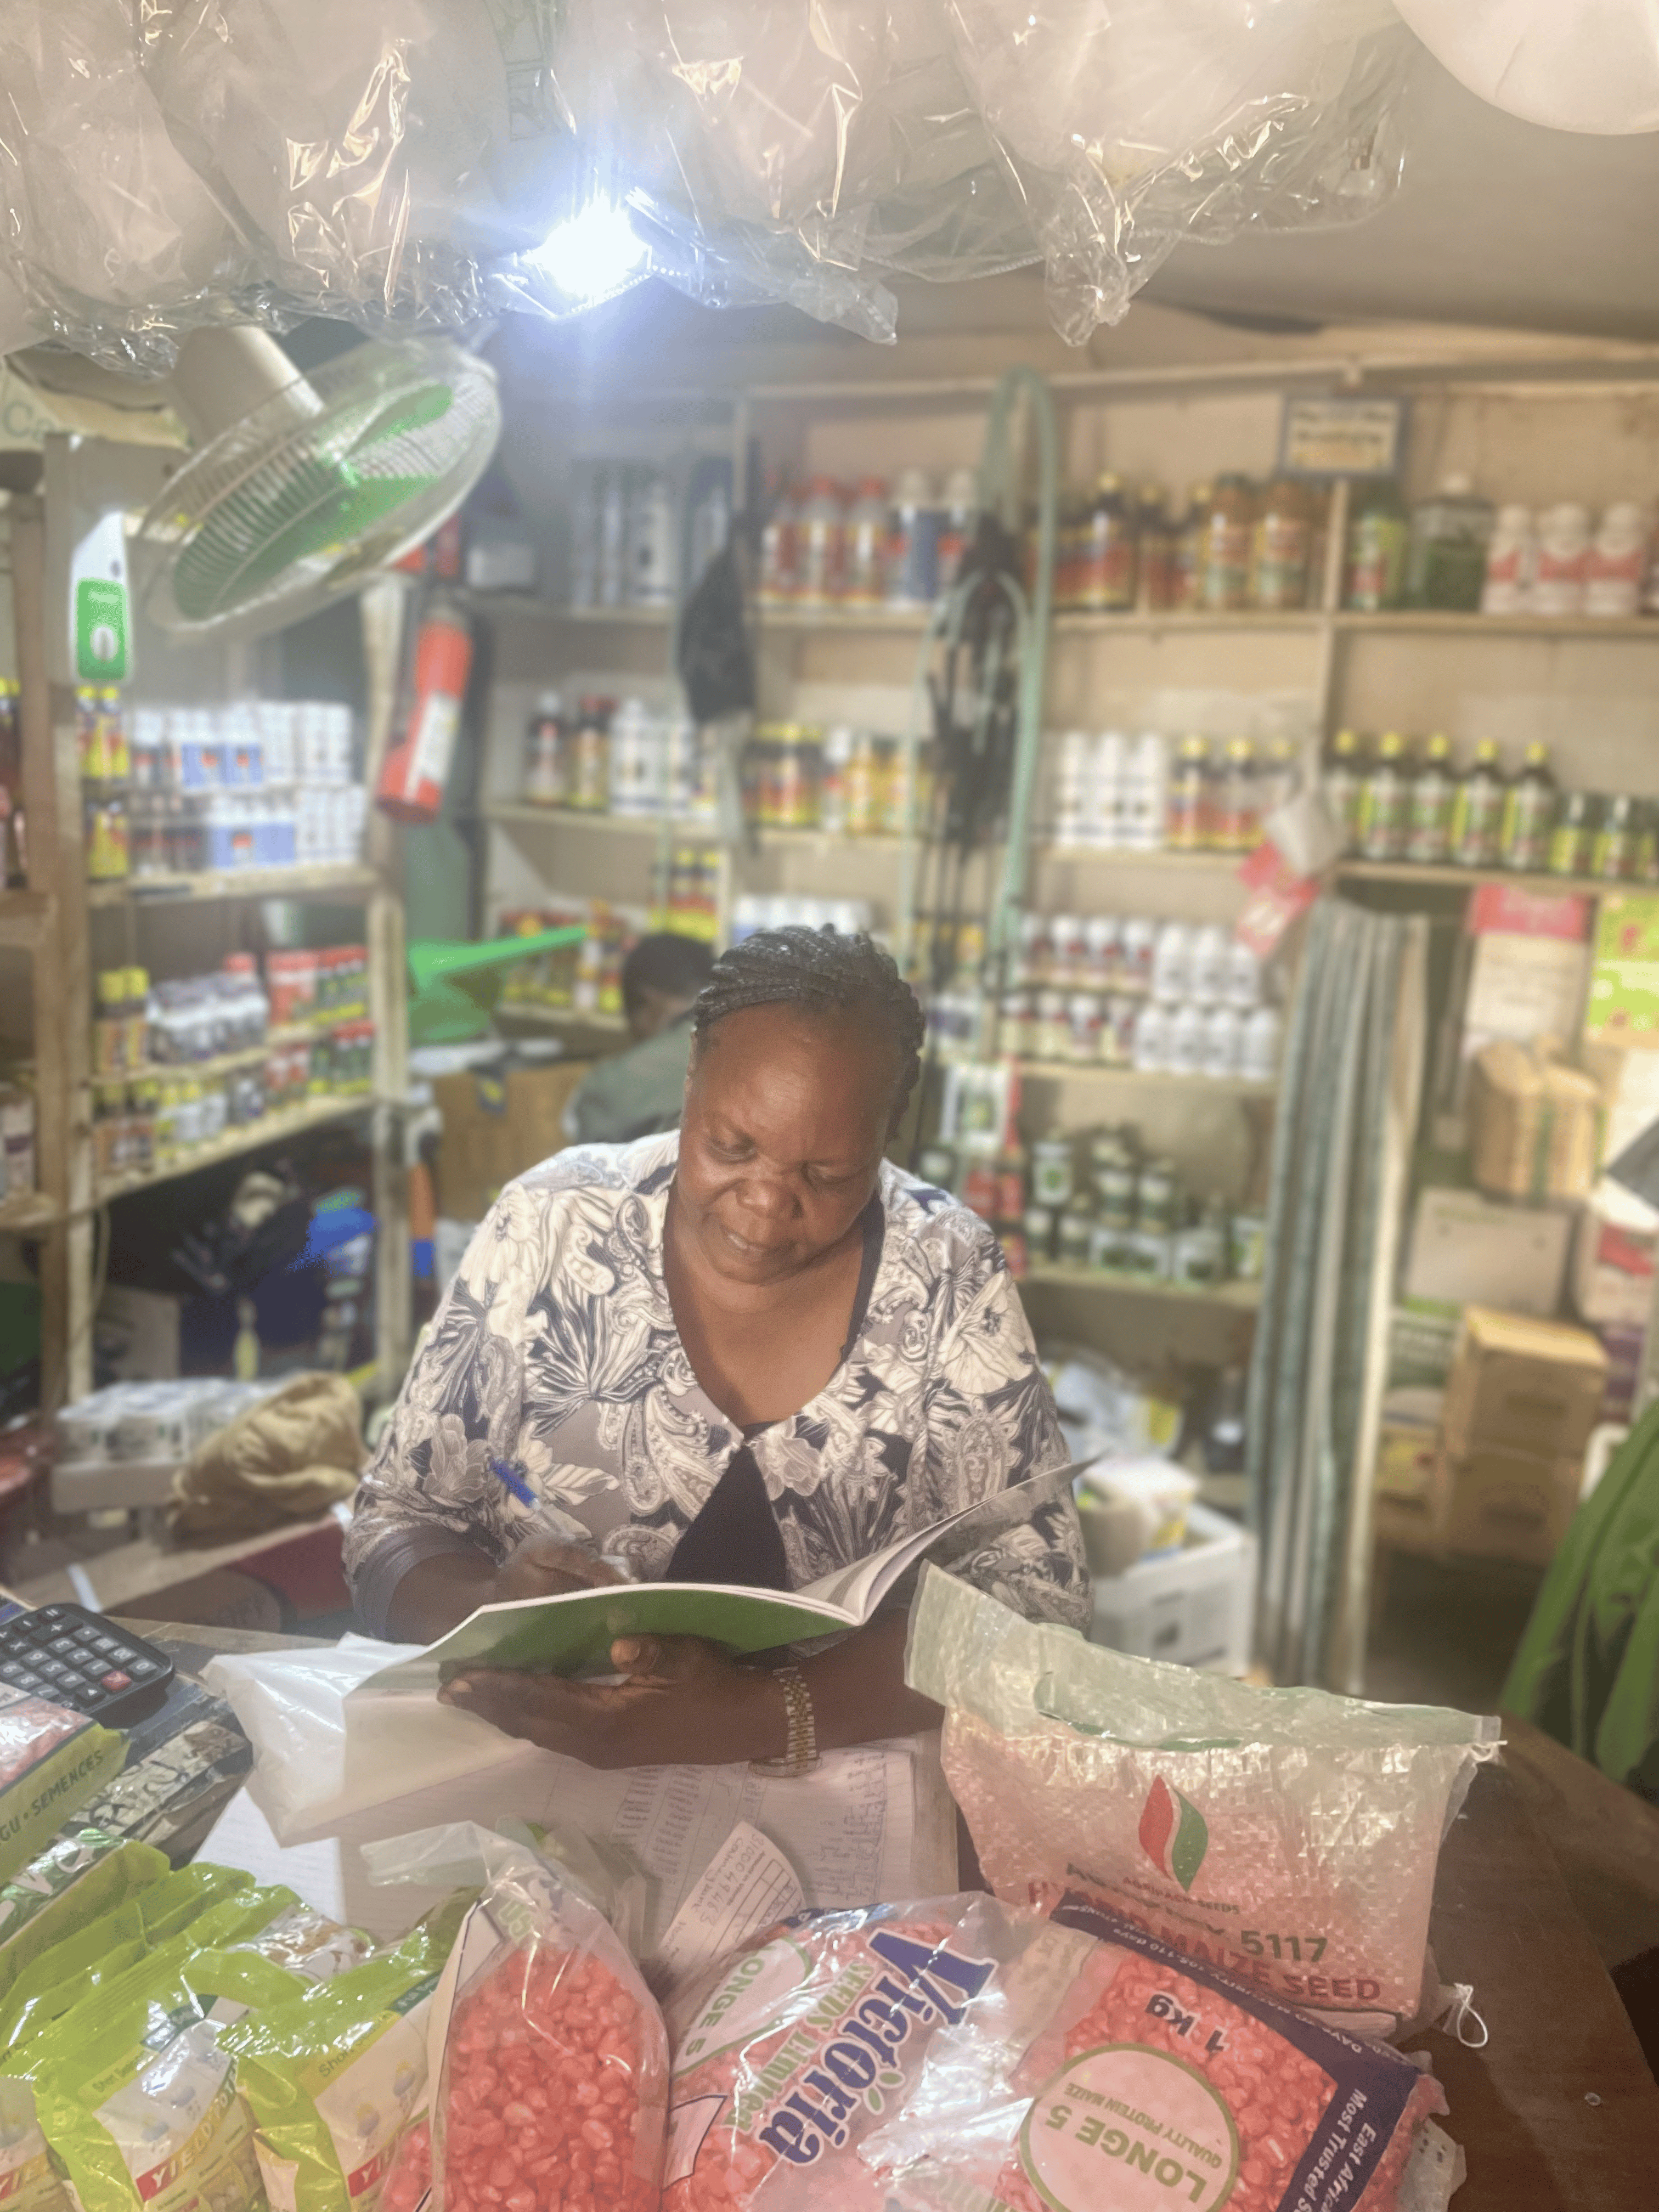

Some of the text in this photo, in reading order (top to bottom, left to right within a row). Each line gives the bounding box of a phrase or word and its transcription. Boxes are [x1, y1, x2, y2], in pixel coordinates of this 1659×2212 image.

[56, 1640, 70, 1648] 3
[46, 1664, 61, 1672] 5
[65, 1675, 77, 1683] 4
[137, 1662, 149, 1671] 0
[31, 1750, 104, 1816] SEMENCES
[1241, 1929, 1328, 1963] 5117
[1284, 1975, 1380, 2000] SEED
[1144, 1993, 1197, 2036] kg
[685, 2038, 707, 2057] 5
[757, 1929, 997, 2164] Victoria
[1045, 2104, 1073, 2131] 5
[1064, 2082, 1223, 2169] QUALITY PROTEIN MAIZE
[1338, 2088, 1367, 2133] Most
[152, 2120, 213, 2190] YIELD
[1075, 2115, 1207, 2204] LONGE
[1348, 2123, 1376, 2165] East
[1304, 2132, 1347, 2202] Trusted
